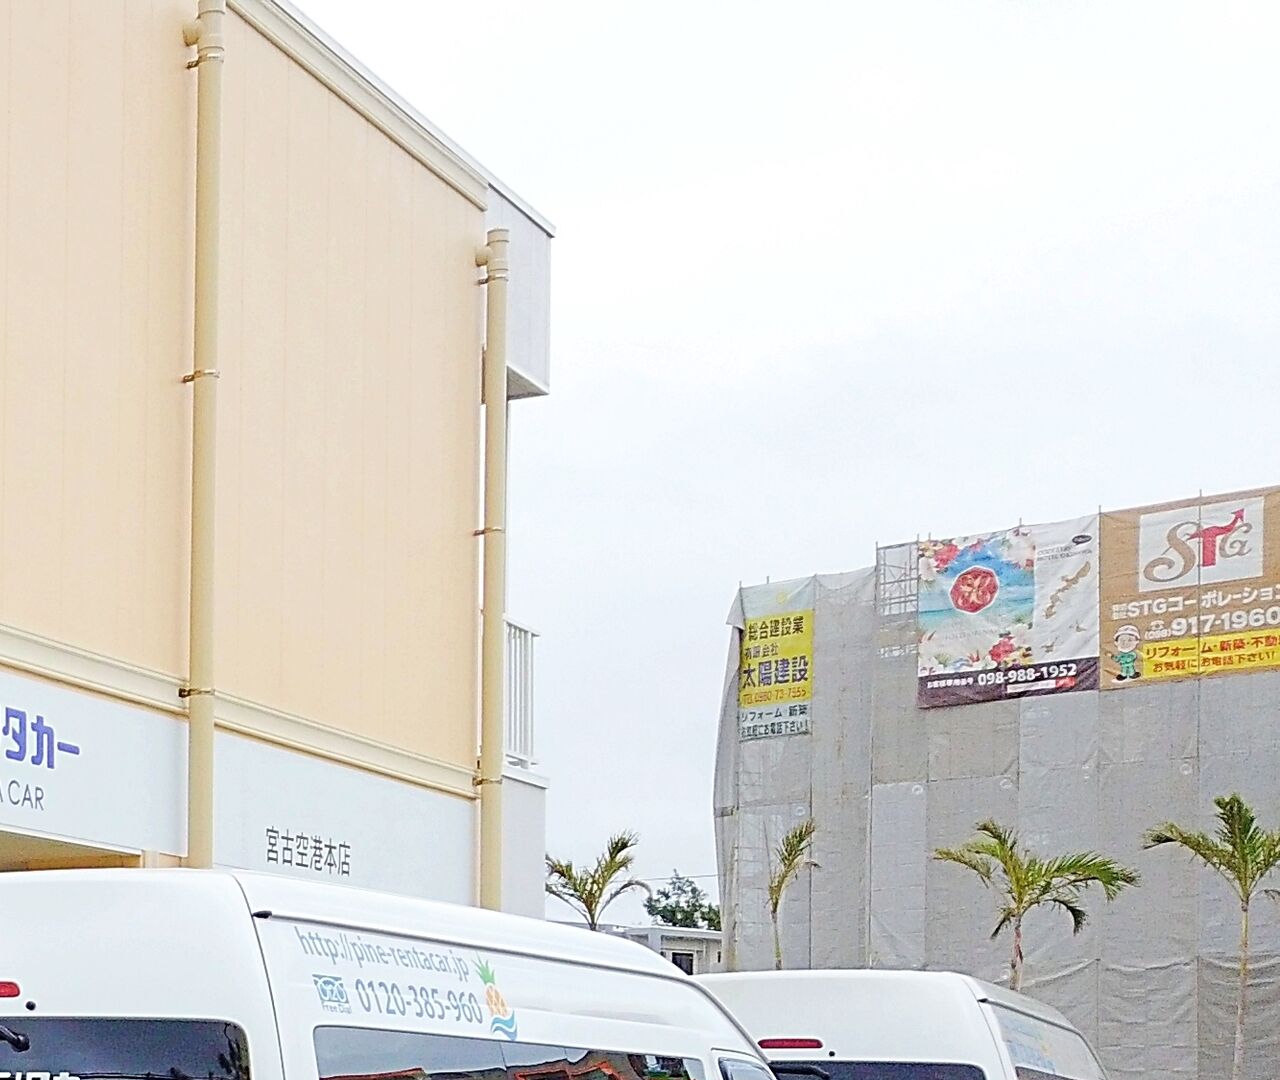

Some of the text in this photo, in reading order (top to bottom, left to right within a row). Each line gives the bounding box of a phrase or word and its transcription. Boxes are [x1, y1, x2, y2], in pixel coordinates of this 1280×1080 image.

[1171, 605, 1280, 636] 917-1960
[1147, 635, 1280, 660] リフォーム・新築・不動
[742, 656, 808, 688] 太陽建設
[978, 663, 1077, 686] 098-988-1952
[8, 780, 44, 811] CAR
[266, 826, 351, 876] 宮古空港本店
[294, 926, 469, 983] http://pine-rentacar.jp
[355, 978, 483, 1024] 0120-385-960
